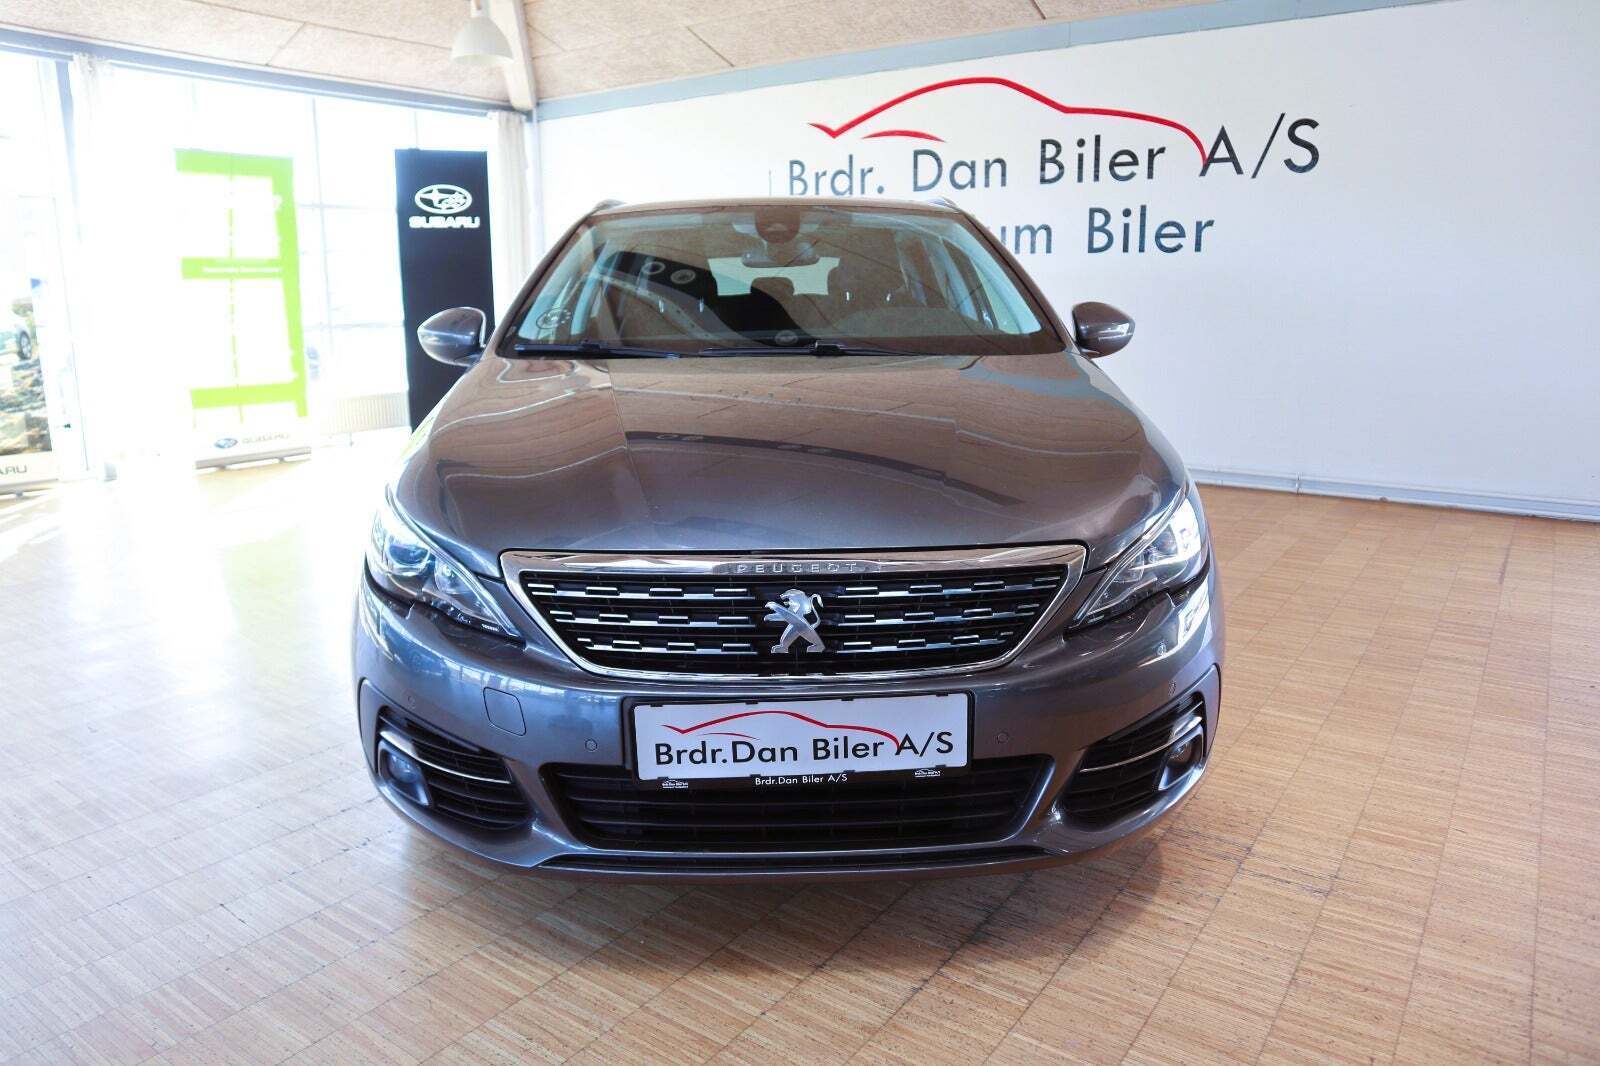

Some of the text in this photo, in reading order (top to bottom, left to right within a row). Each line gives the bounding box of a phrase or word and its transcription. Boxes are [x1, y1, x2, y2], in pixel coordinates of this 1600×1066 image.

[789, 112, 1320, 196] Brdr. Dan Biler A/S
[409, 216, 480, 228] SUBARU
[1087, 205, 1215, 254] Biler
[736, 562, 857, 573] PEUGEOT
[812, 736, 885, 761] Biler
[895, 731, 954, 756] A/S
[802, 774, 824, 784] Biler
[827, 773, 848, 783] A/S
